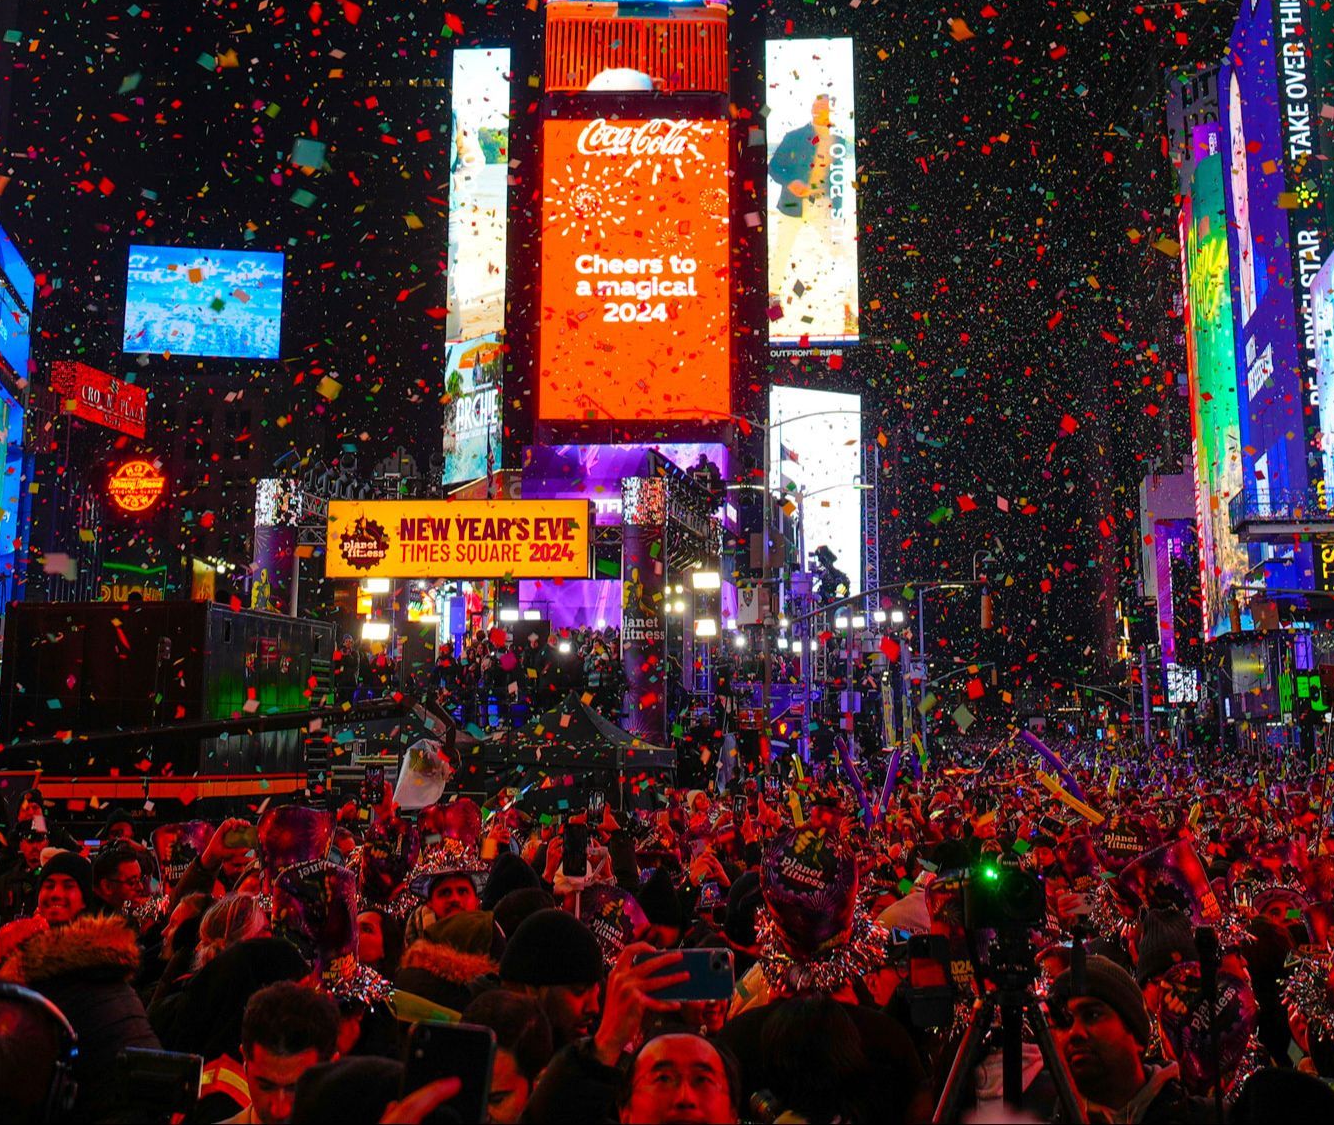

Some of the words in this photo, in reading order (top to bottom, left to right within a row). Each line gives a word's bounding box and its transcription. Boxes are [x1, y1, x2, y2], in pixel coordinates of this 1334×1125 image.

[1283, 43, 1307, 99] OVER
[1287, 103, 1312, 160] TAKE
[574, 254, 664, 275] Cheers
[669, 254, 697, 275] to
[575, 280, 593, 297] a
[596, 276, 698, 300] magical
[602, 302, 668, 323] 2024
[400, 517, 450, 541] NEW
[455, 517, 530, 541] YEAR'S
[534, 517, 575, 541] EVE
[400, 543, 450, 563] TIMES
[456, 542, 522, 563] SQUARE
[529, 542, 575, 563] 2024
[1103, 832, 1138, 844] planet
[1107, 839, 1144, 853] fitness
[164, 863, 190, 874] plane
[780, 855, 824, 878] planet
[782, 866, 827, 891] fitness
[591, 917, 625, 939] planet
